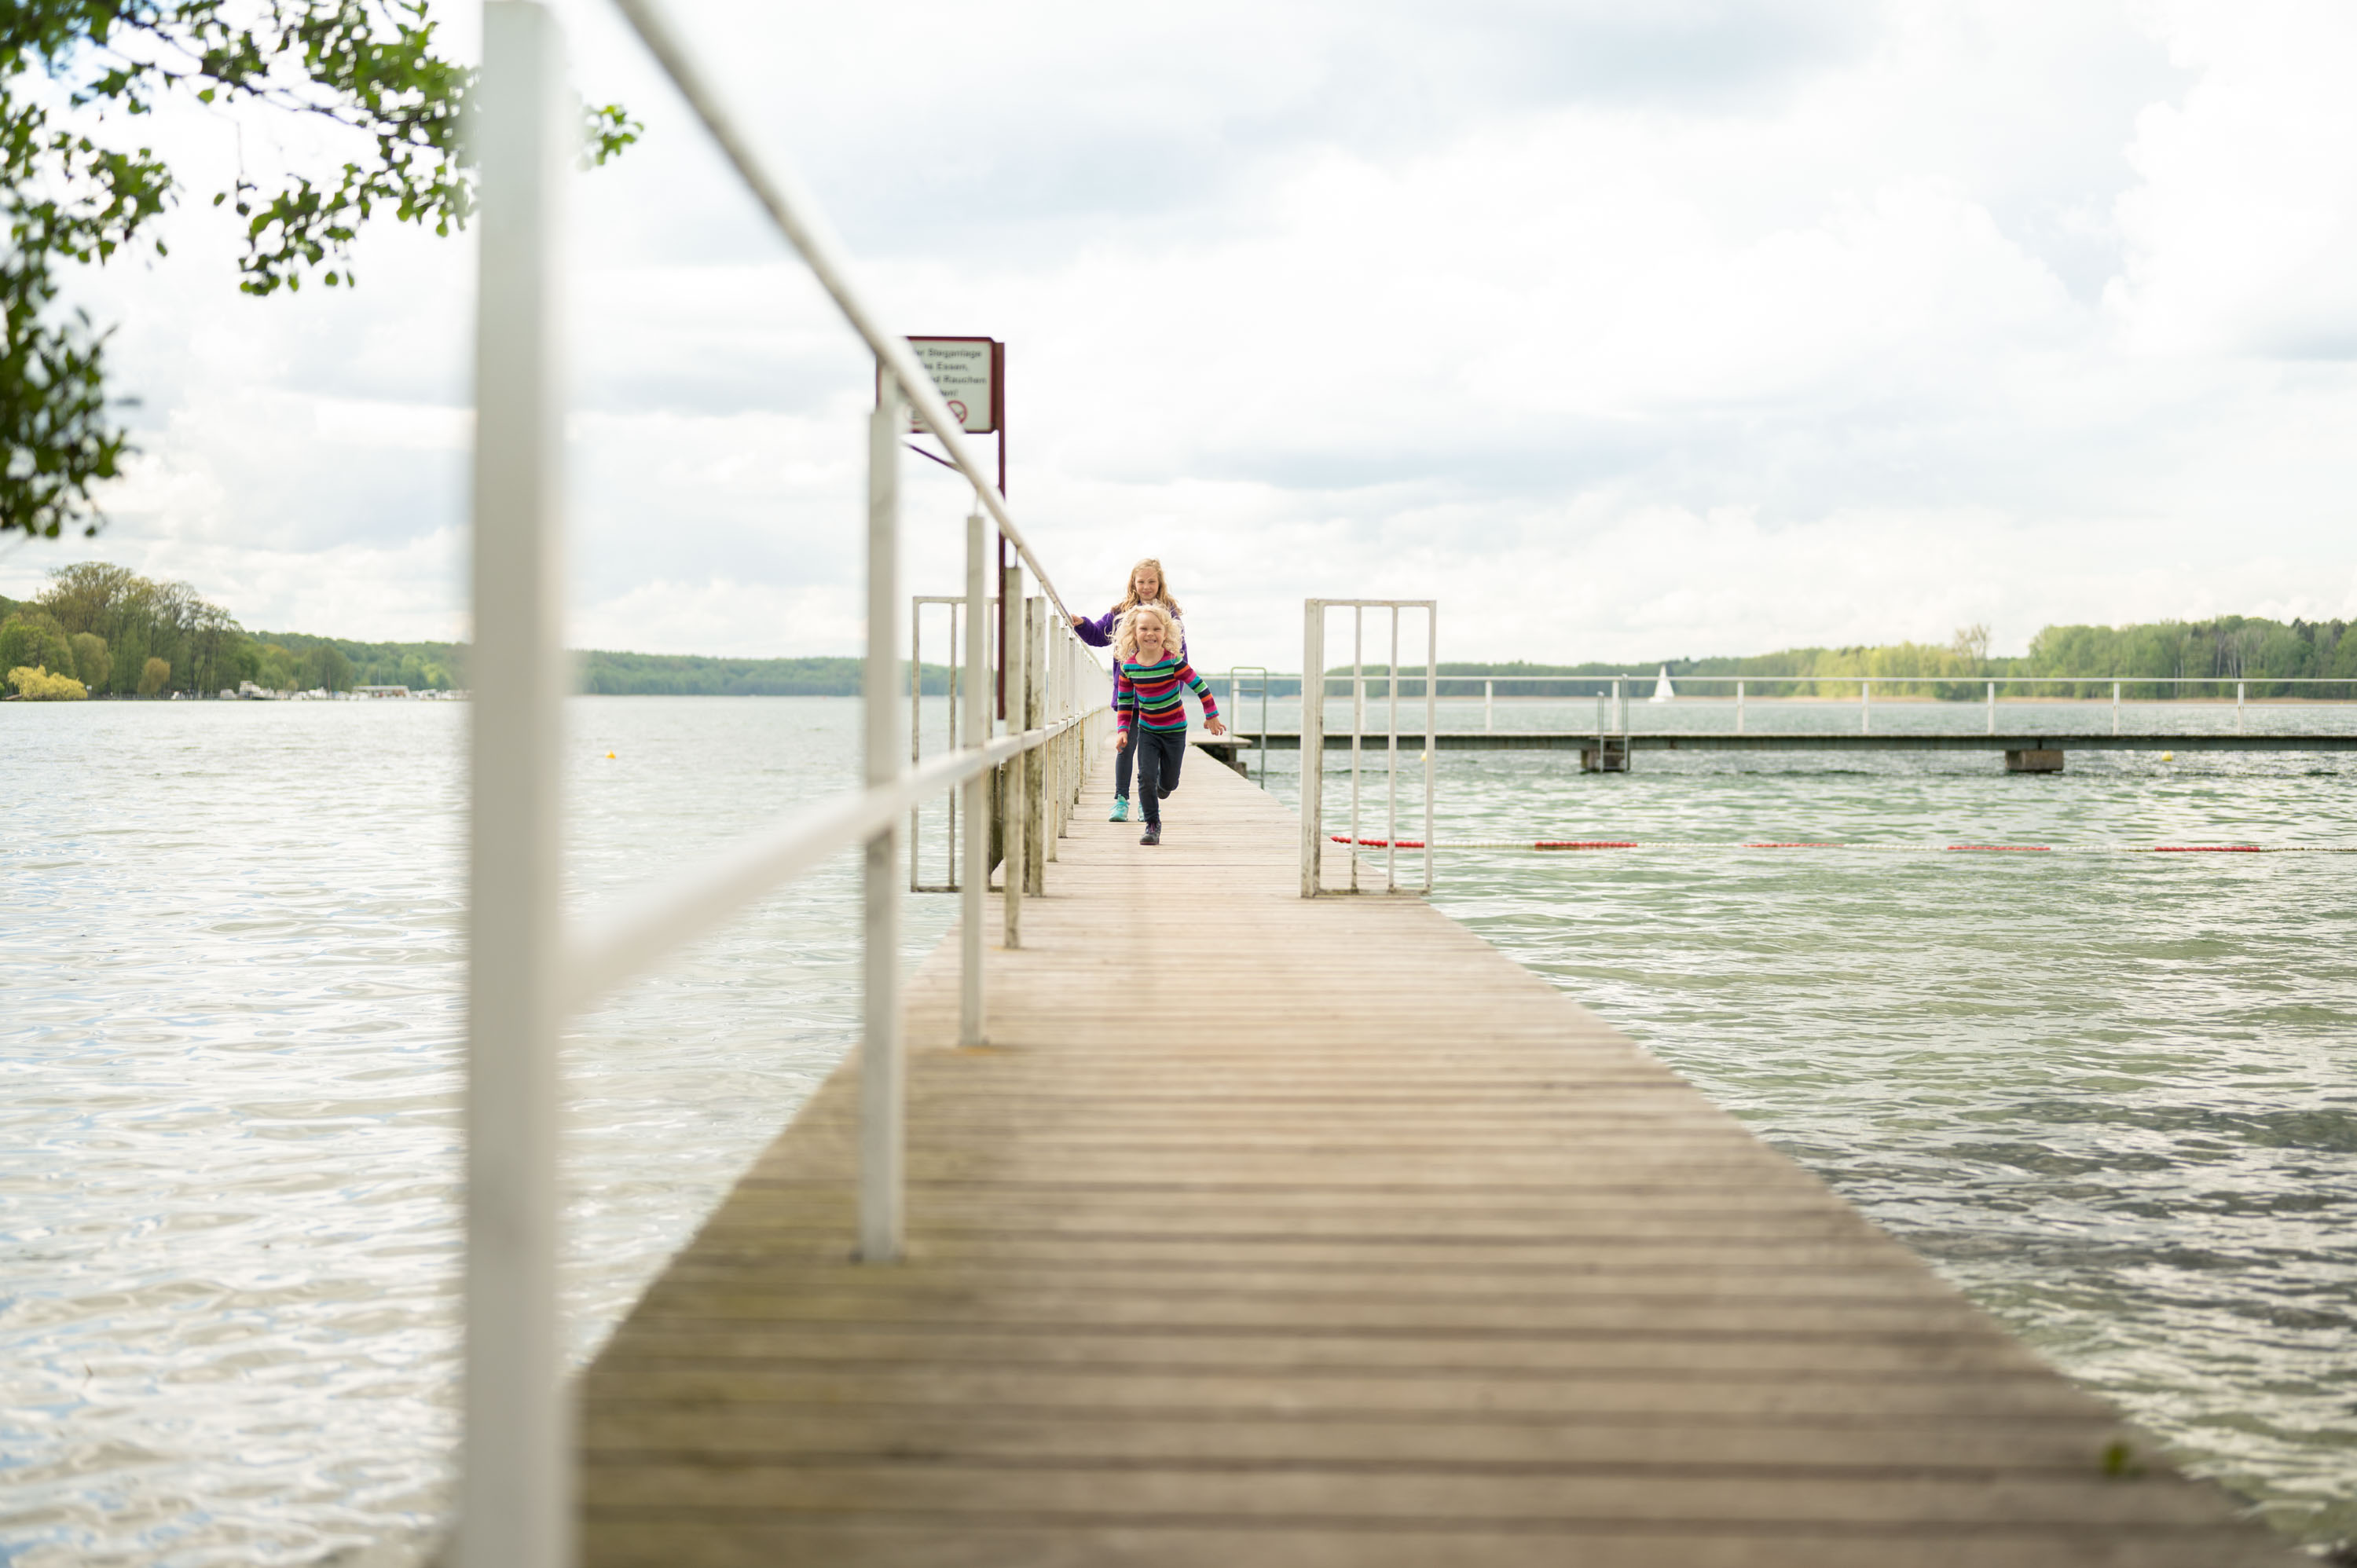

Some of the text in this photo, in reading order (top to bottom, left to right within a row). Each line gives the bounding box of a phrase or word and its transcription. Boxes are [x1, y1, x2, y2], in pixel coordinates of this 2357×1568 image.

[928, 348, 981, 359] Steganlage
[936, 361, 968, 371] Essen,
[943, 375, 987, 383] Rauchen
